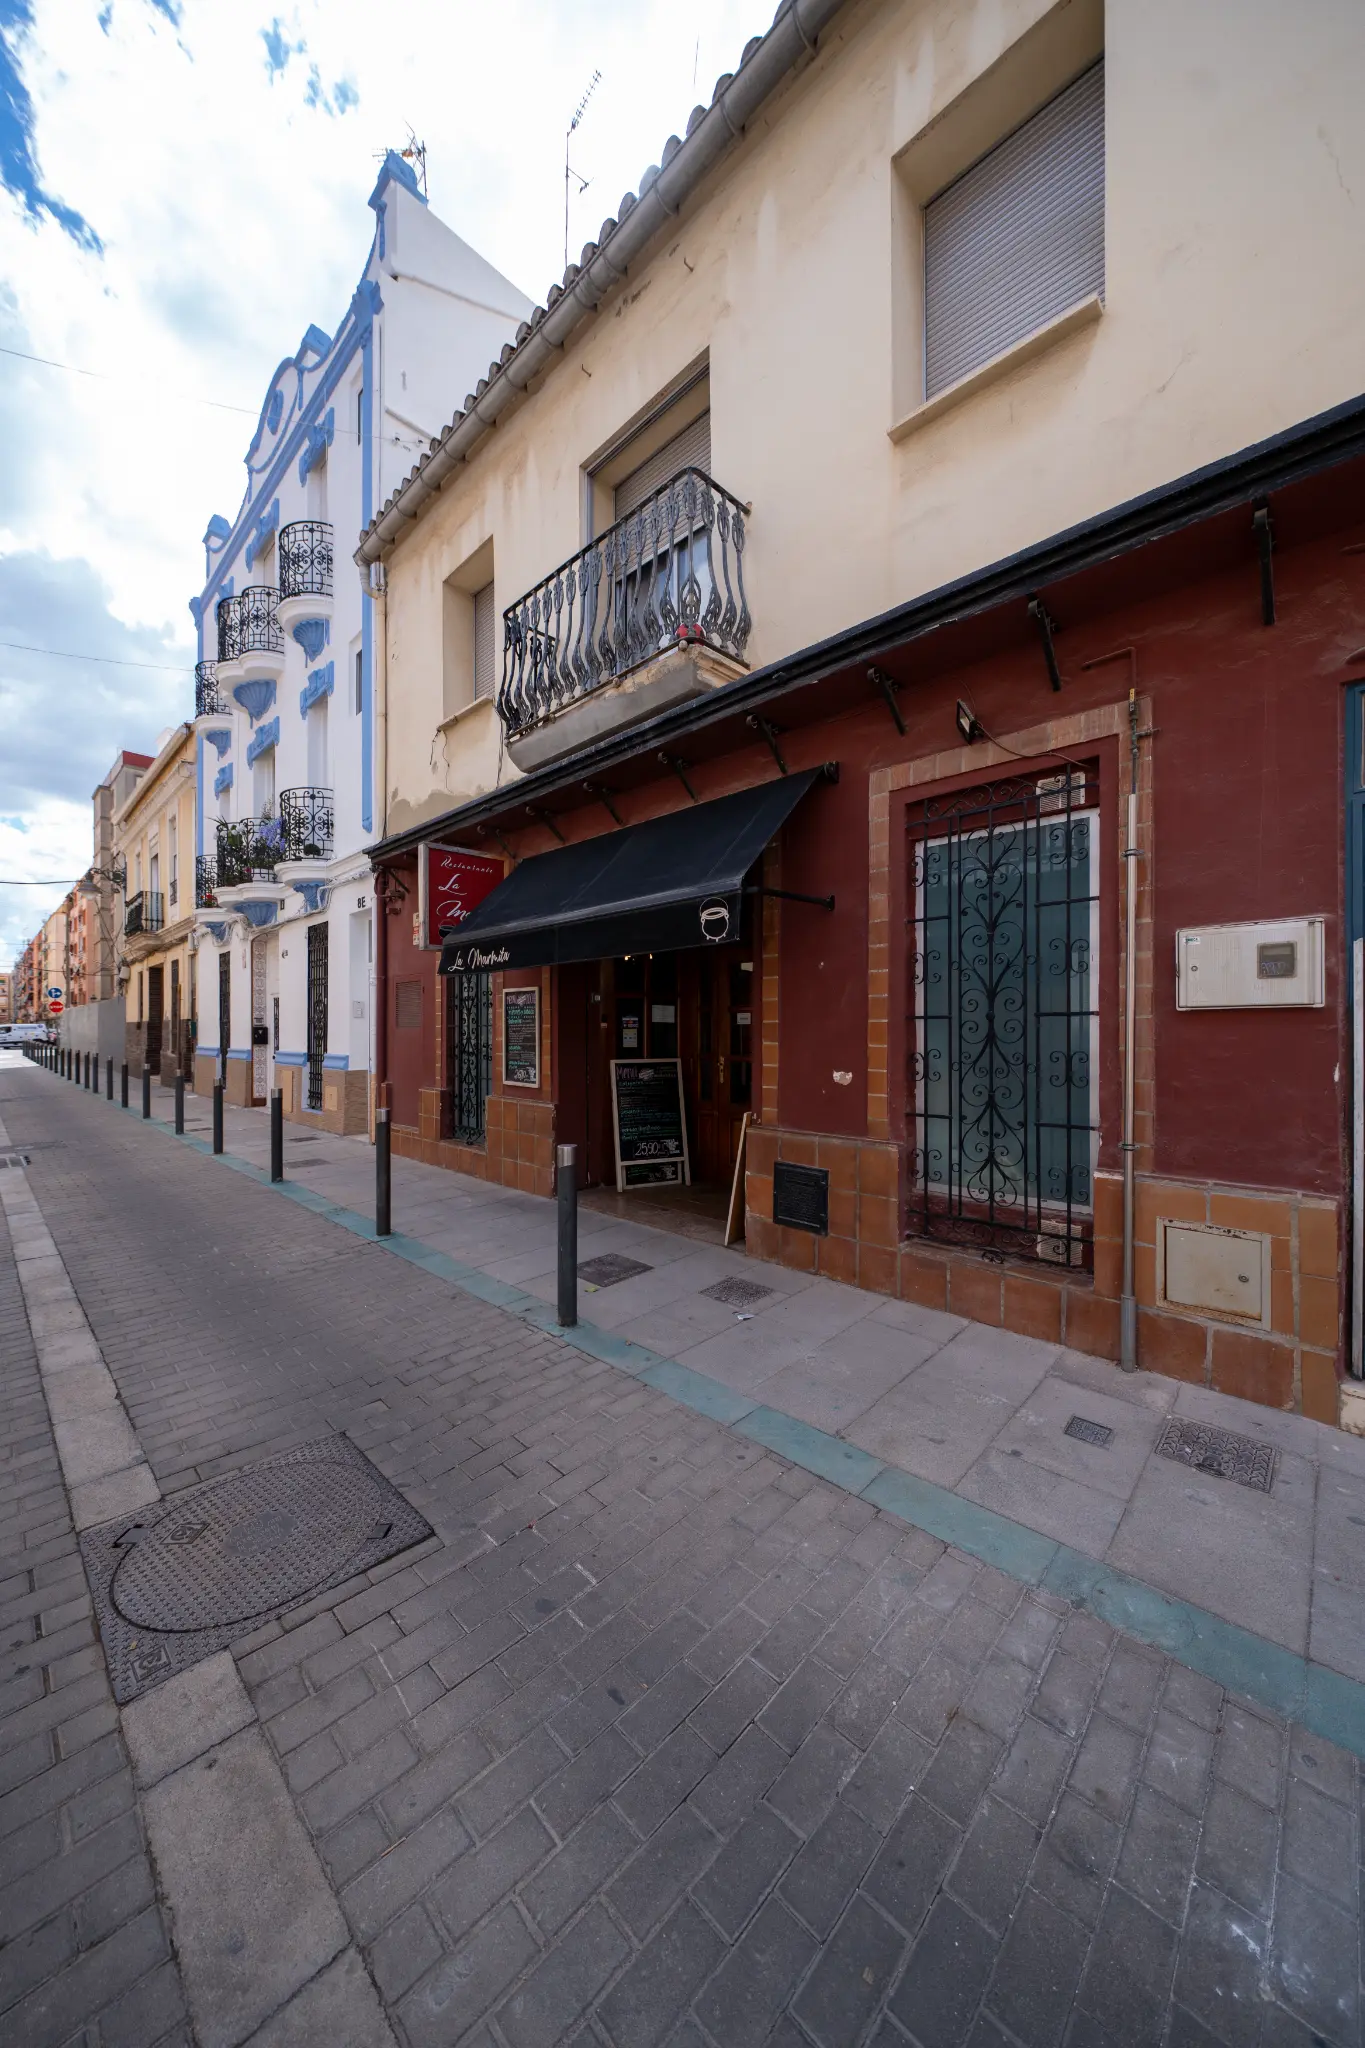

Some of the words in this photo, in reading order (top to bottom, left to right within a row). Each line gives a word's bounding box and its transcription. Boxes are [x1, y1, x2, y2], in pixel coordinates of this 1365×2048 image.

[437, 873, 467, 896] La
[447, 951, 465, 972] La
[468, 946, 510, 970] Marmita
